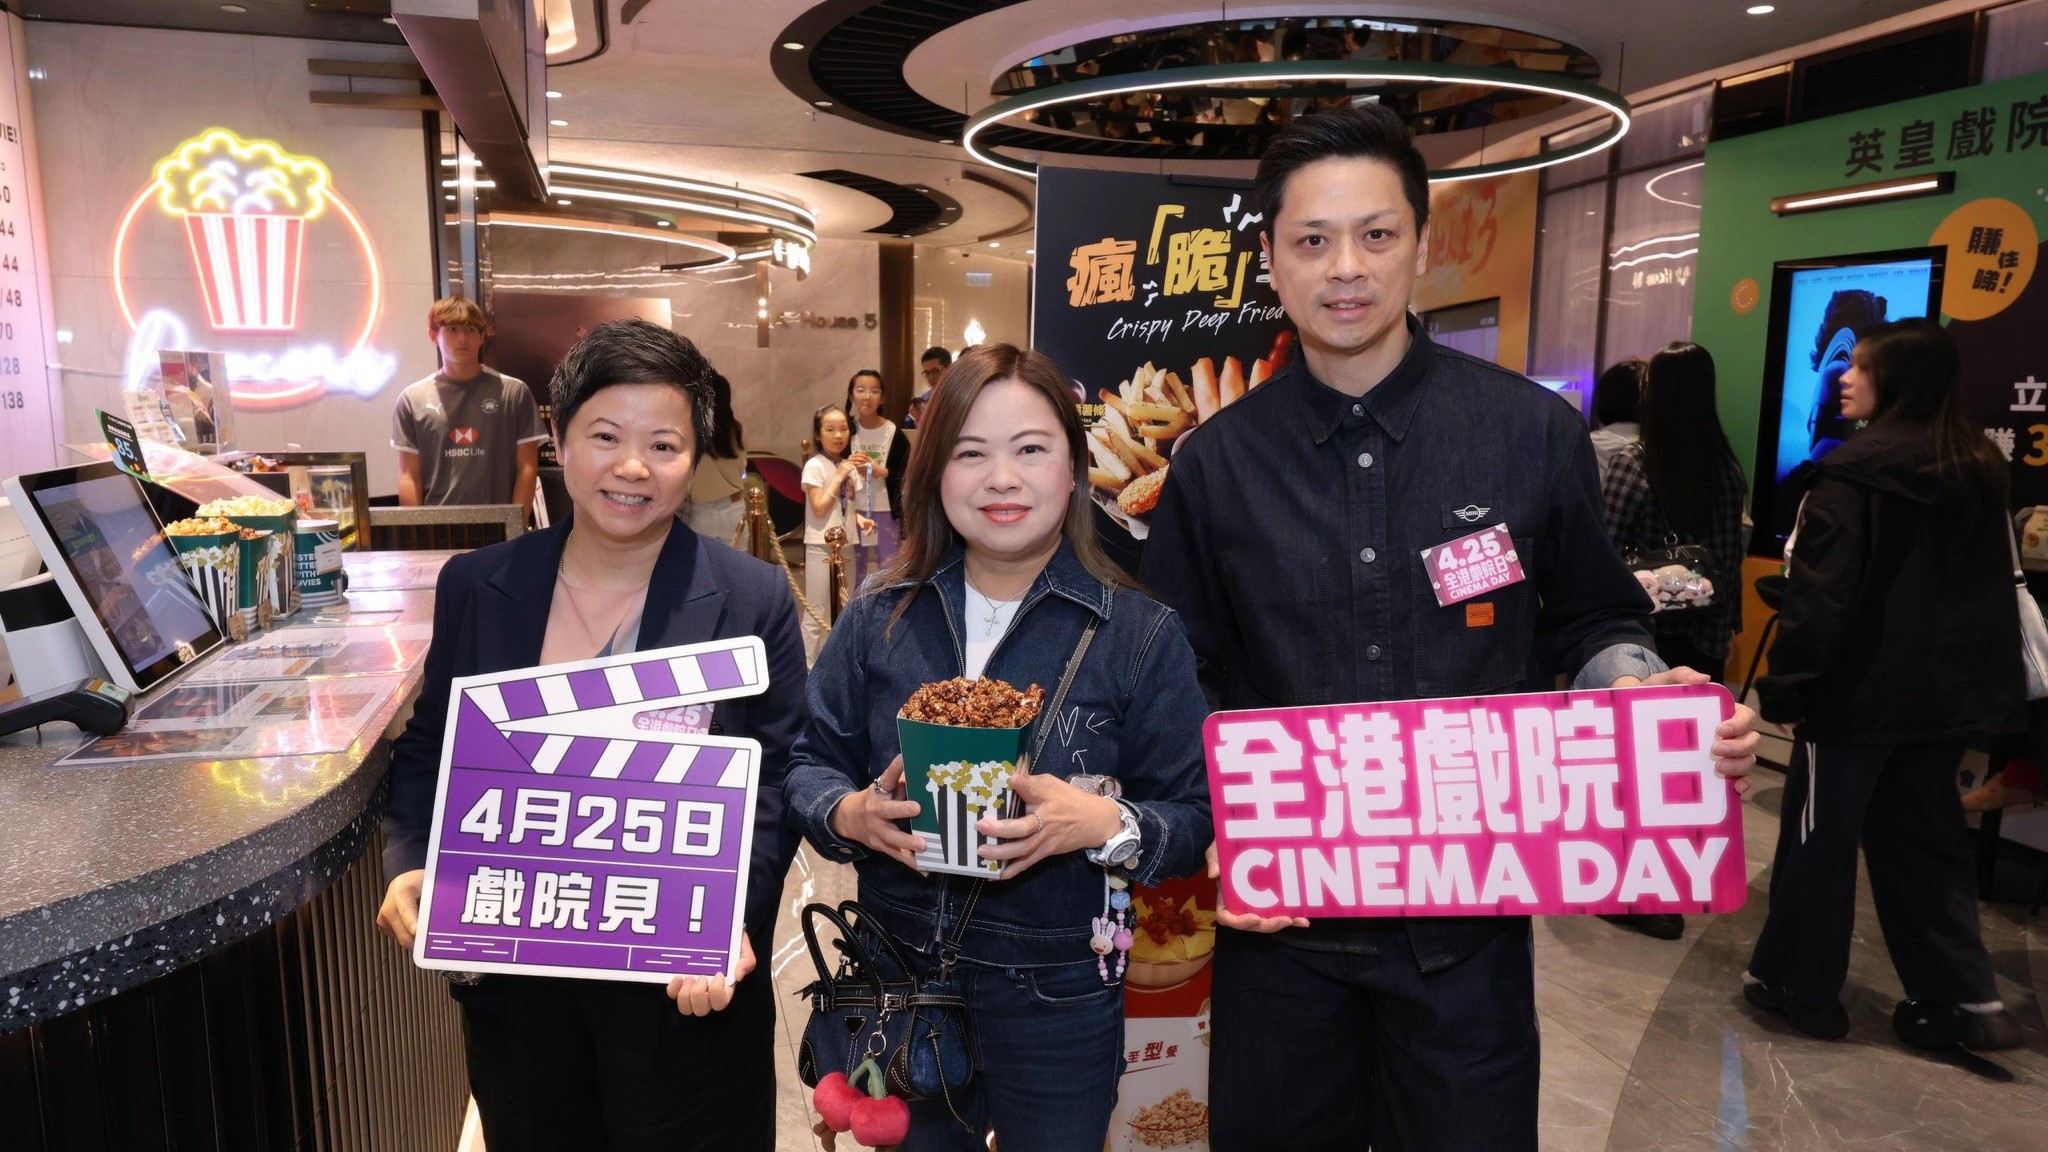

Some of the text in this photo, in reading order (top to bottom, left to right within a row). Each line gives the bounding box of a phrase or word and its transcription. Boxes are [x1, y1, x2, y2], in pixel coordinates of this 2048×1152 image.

[0, 122, 18, 145] IE!
[1845, 95, 2048, 178] 英皇戲院
[1066, 204, 1271, 308] 瘋「脆」
[1106, 316, 1174, 344] Crispy
[1181, 309, 1230, 336] Deep
[444, 448, 470, 457] HSBC
[1438, 531, 1501, 571] 4.25
[1443, 555, 1509, 591] 全港戲院日
[1449, 572, 1511, 600] CINEMA DAY
[1214, 696, 1728, 839] 全港戲院日
[459, 787, 726, 858] 4月25日
[460, 865, 706, 935] 戲院見！
[1230, 836, 1729, 909] CINEMA DAY
